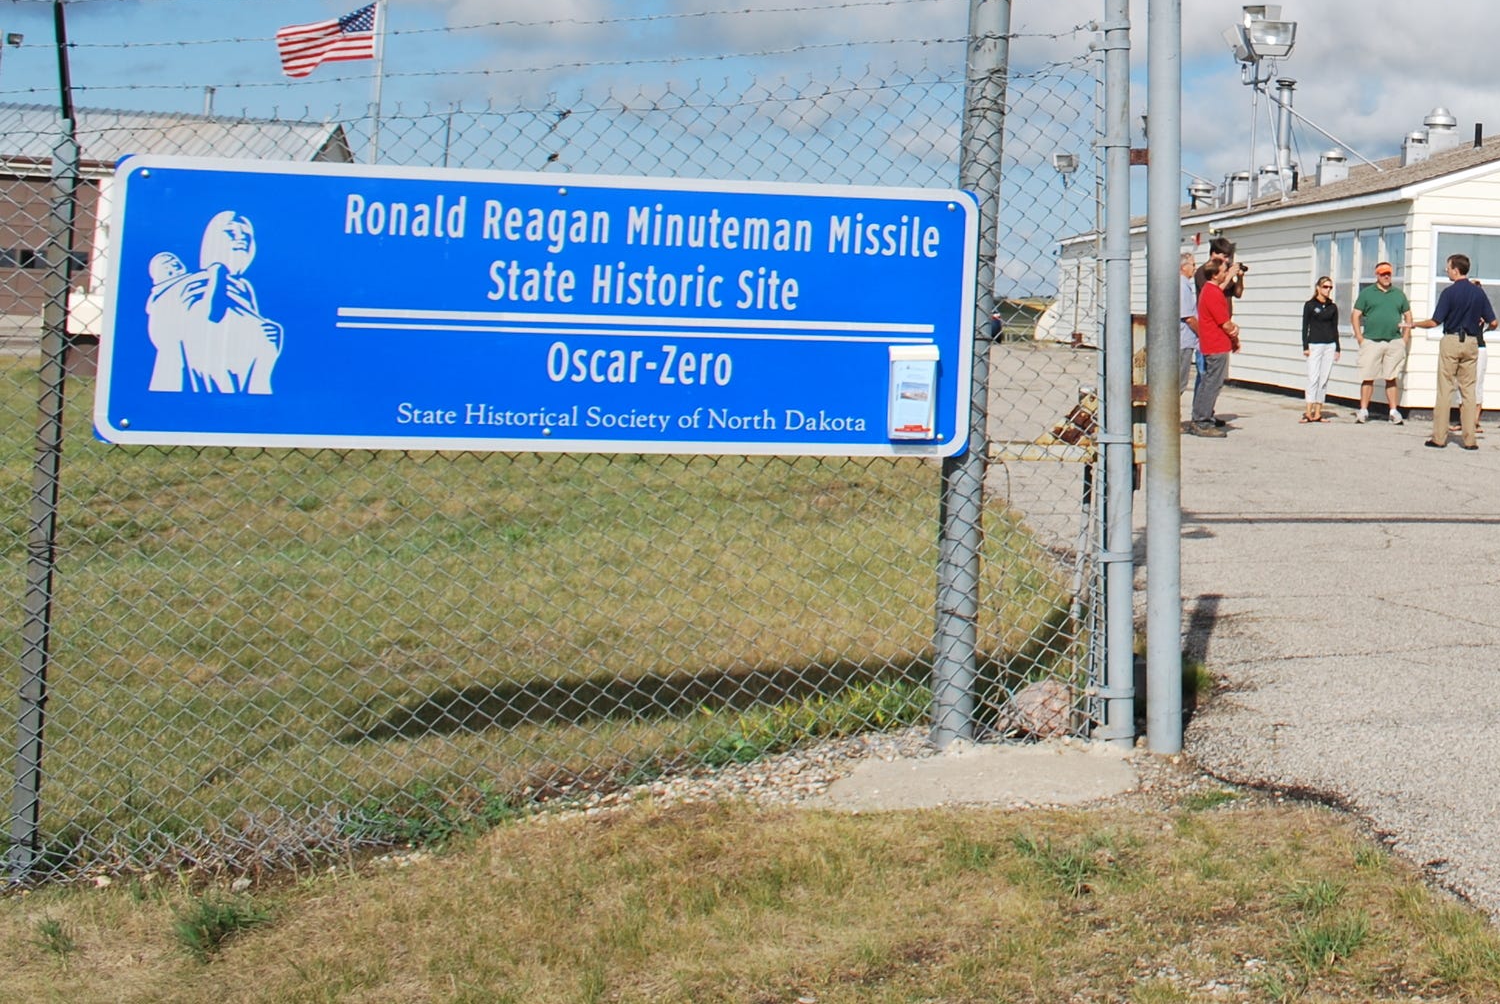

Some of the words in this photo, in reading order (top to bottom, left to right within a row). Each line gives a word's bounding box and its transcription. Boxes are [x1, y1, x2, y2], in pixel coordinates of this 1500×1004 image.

[344, 193, 467, 239] Ronald
[482, 199, 610, 254] Reagan
[626, 203, 812, 253] Minuteman
[828, 212, 941, 258] Missile
[487, 260, 576, 303] State
[591, 263, 725, 308] Historic
[737, 266, 801, 311] Site
[546, 341, 733, 387] Oscar-Zero
[397, 402, 457, 426] State
[464, 403, 577, 427] Historical
[586, 406, 671, 435] Society
[678, 407, 702, 429] of
[707, 408, 776, 430] North
[784, 409, 866, 431] Dakota
